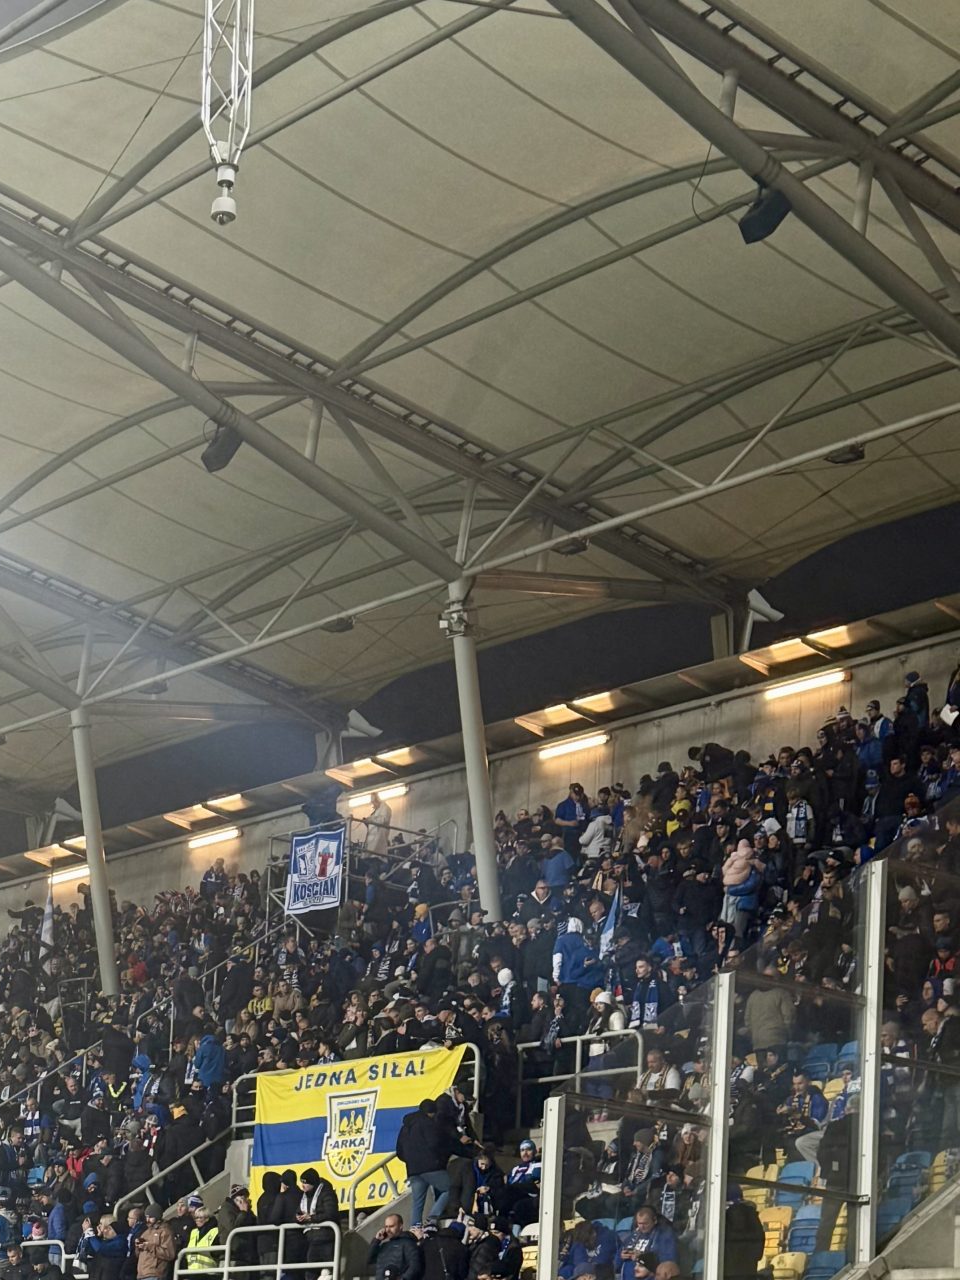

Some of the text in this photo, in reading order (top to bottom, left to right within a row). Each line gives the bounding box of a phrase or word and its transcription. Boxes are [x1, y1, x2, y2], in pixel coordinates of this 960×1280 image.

[294, 1059, 425, 1091] JEDNA SIŁA!
[332, 1137, 366, 1150] ARKA
